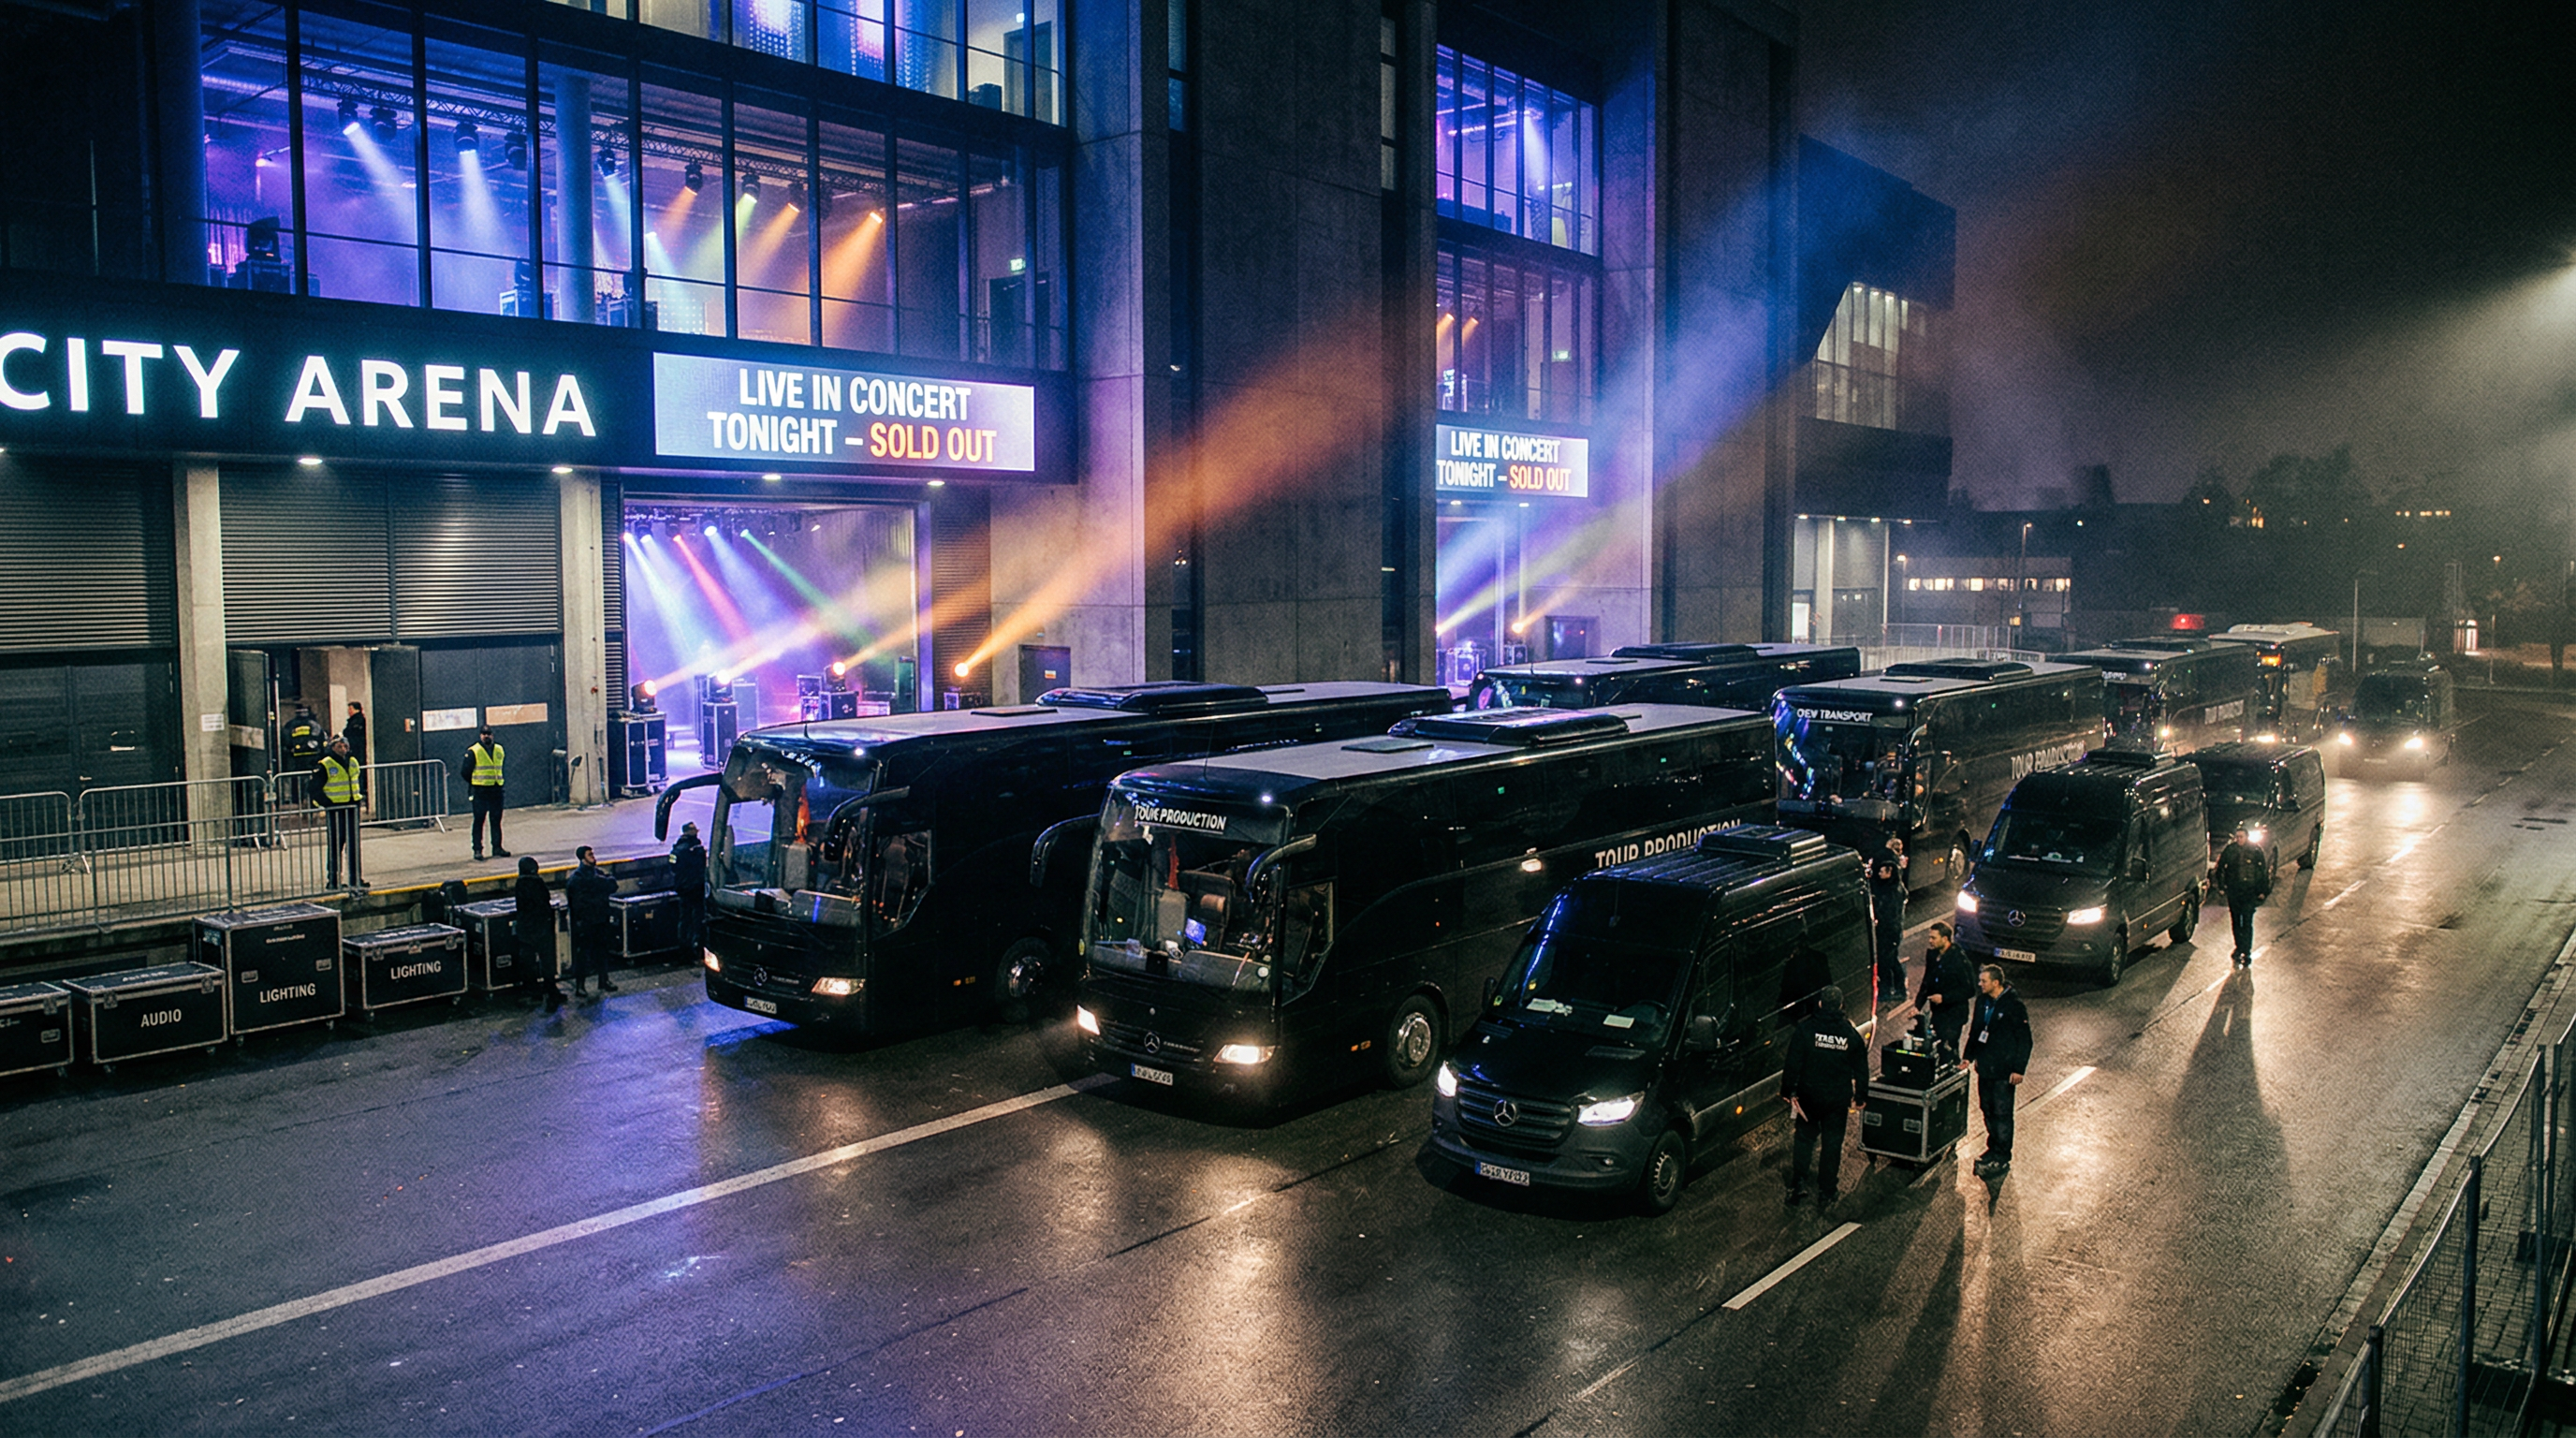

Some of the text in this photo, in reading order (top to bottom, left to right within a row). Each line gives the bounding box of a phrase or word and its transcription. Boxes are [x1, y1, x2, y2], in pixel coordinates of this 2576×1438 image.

[0, 331, 596, 437] CITY ARENA
[739, 368, 972, 420] LIVE IN CONCERT
[707, 411, 838, 455] TONIGHT
[869, 421, 940, 460] SOLD
[946, 427, 997, 462] OUT
[1451, 431, 1561, 463] LIVE IN CONCERT
[1437, 460, 1497, 488] TONIGHT
[1509, 464, 1544, 490] SOLD
[1546, 468, 1572, 492] OUT
[1820, 710, 1873, 722] TRANSPORT
[390, 961, 442, 980] LIGHTING
[259, 983, 316, 1004] LIGHTING
[140, 1008, 183, 1028] AUDIO
